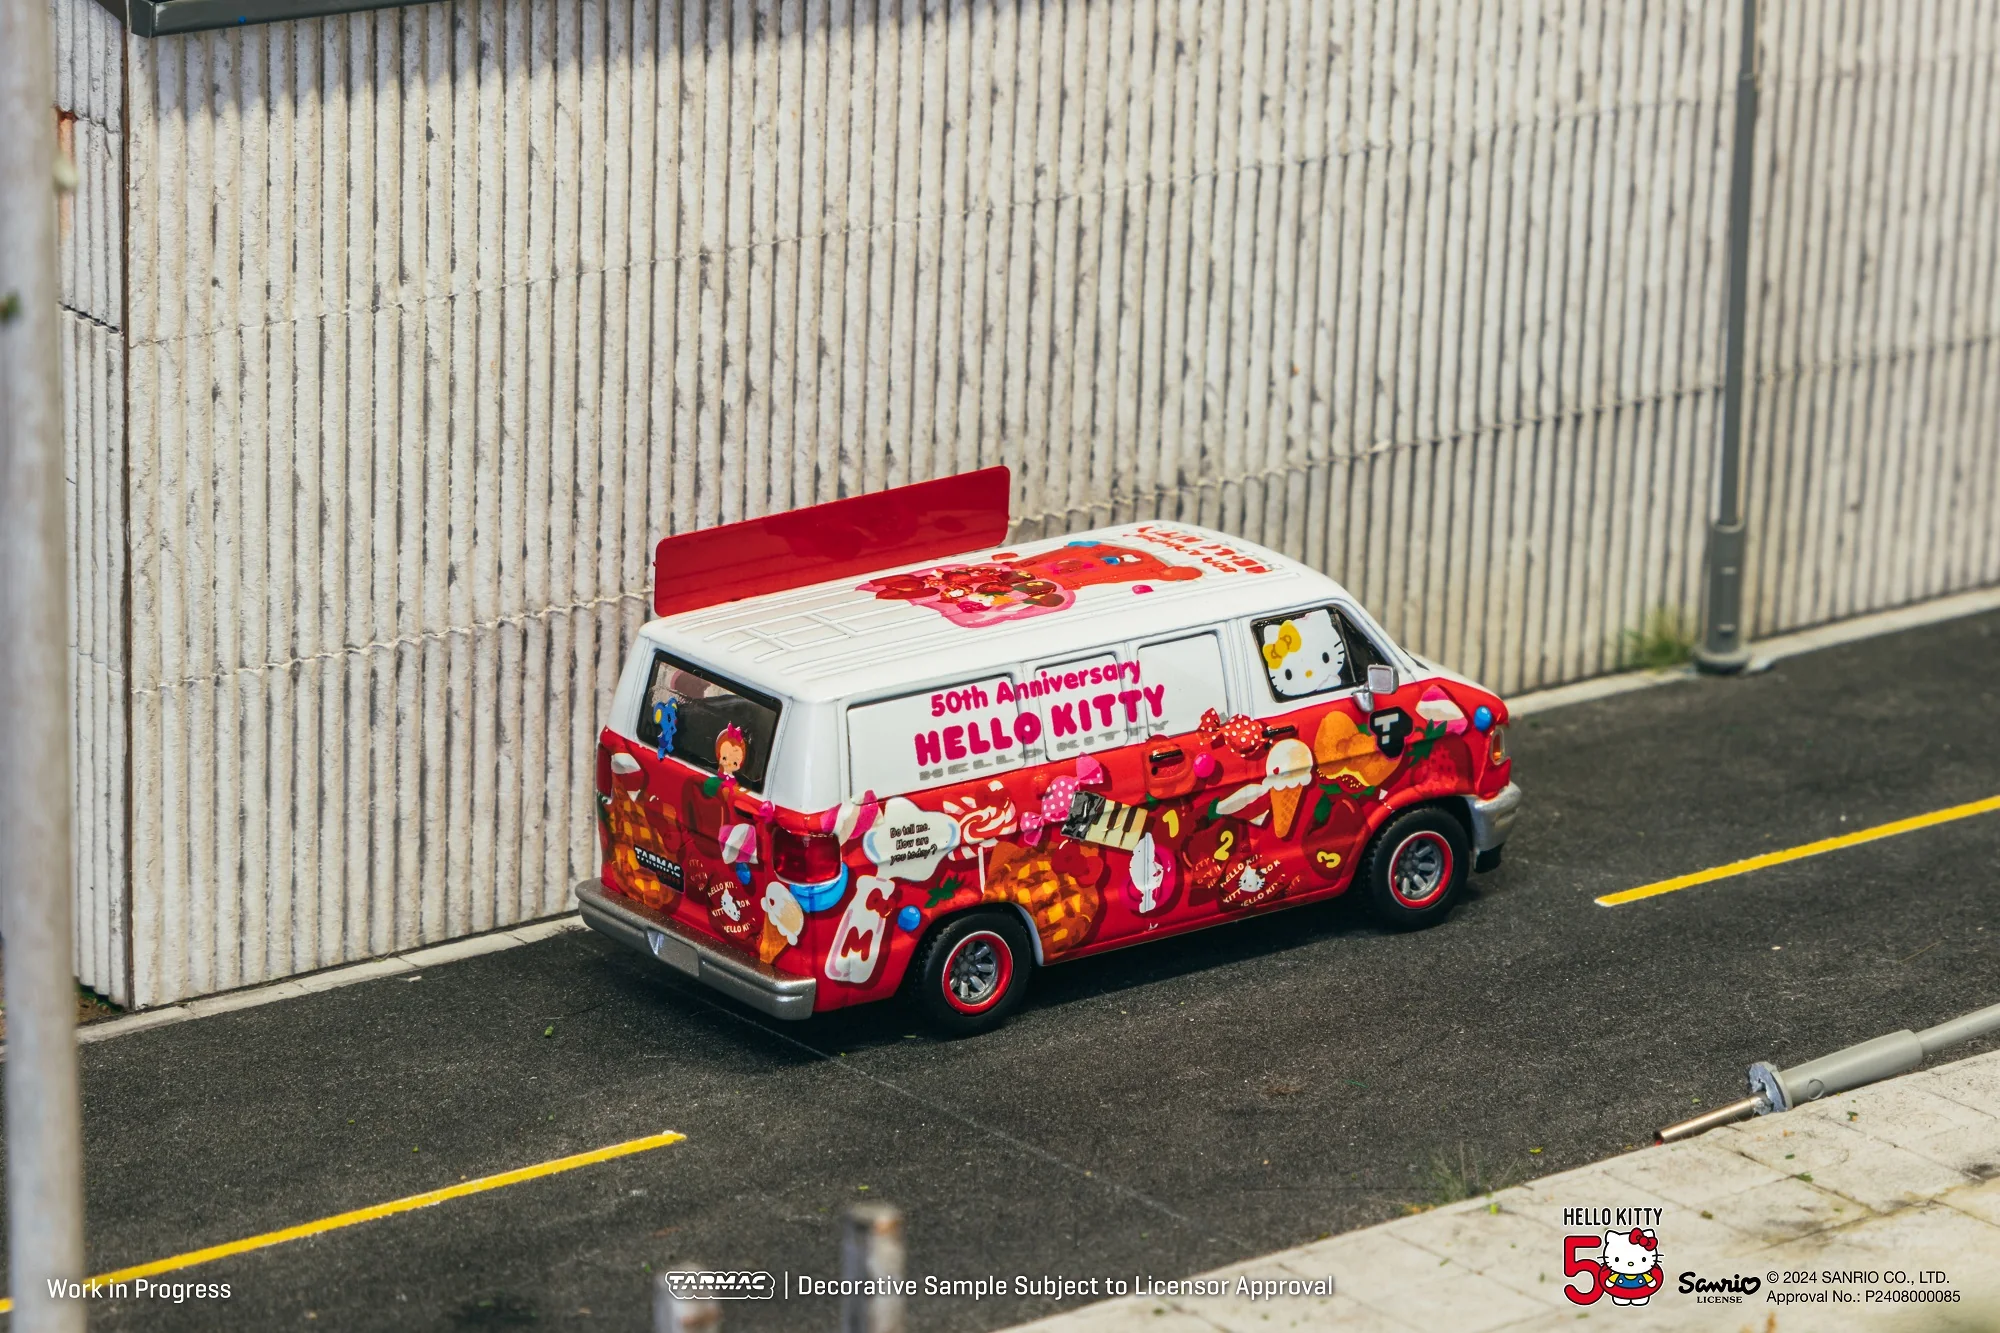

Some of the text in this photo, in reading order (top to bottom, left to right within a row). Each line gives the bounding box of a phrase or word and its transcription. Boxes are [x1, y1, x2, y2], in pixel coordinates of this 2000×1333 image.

[931, 659, 1141, 717] 50th Anniversary
[914, 684, 1165, 767] HELLO KITTY
[1162, 809, 1179, 838] 1
[896, 836, 929, 850] How are
[1214, 831, 1234, 861] 2
[634, 847, 681, 878] TARMAC
[890, 853, 907, 866] you
[841, 926, 874, 962] M
